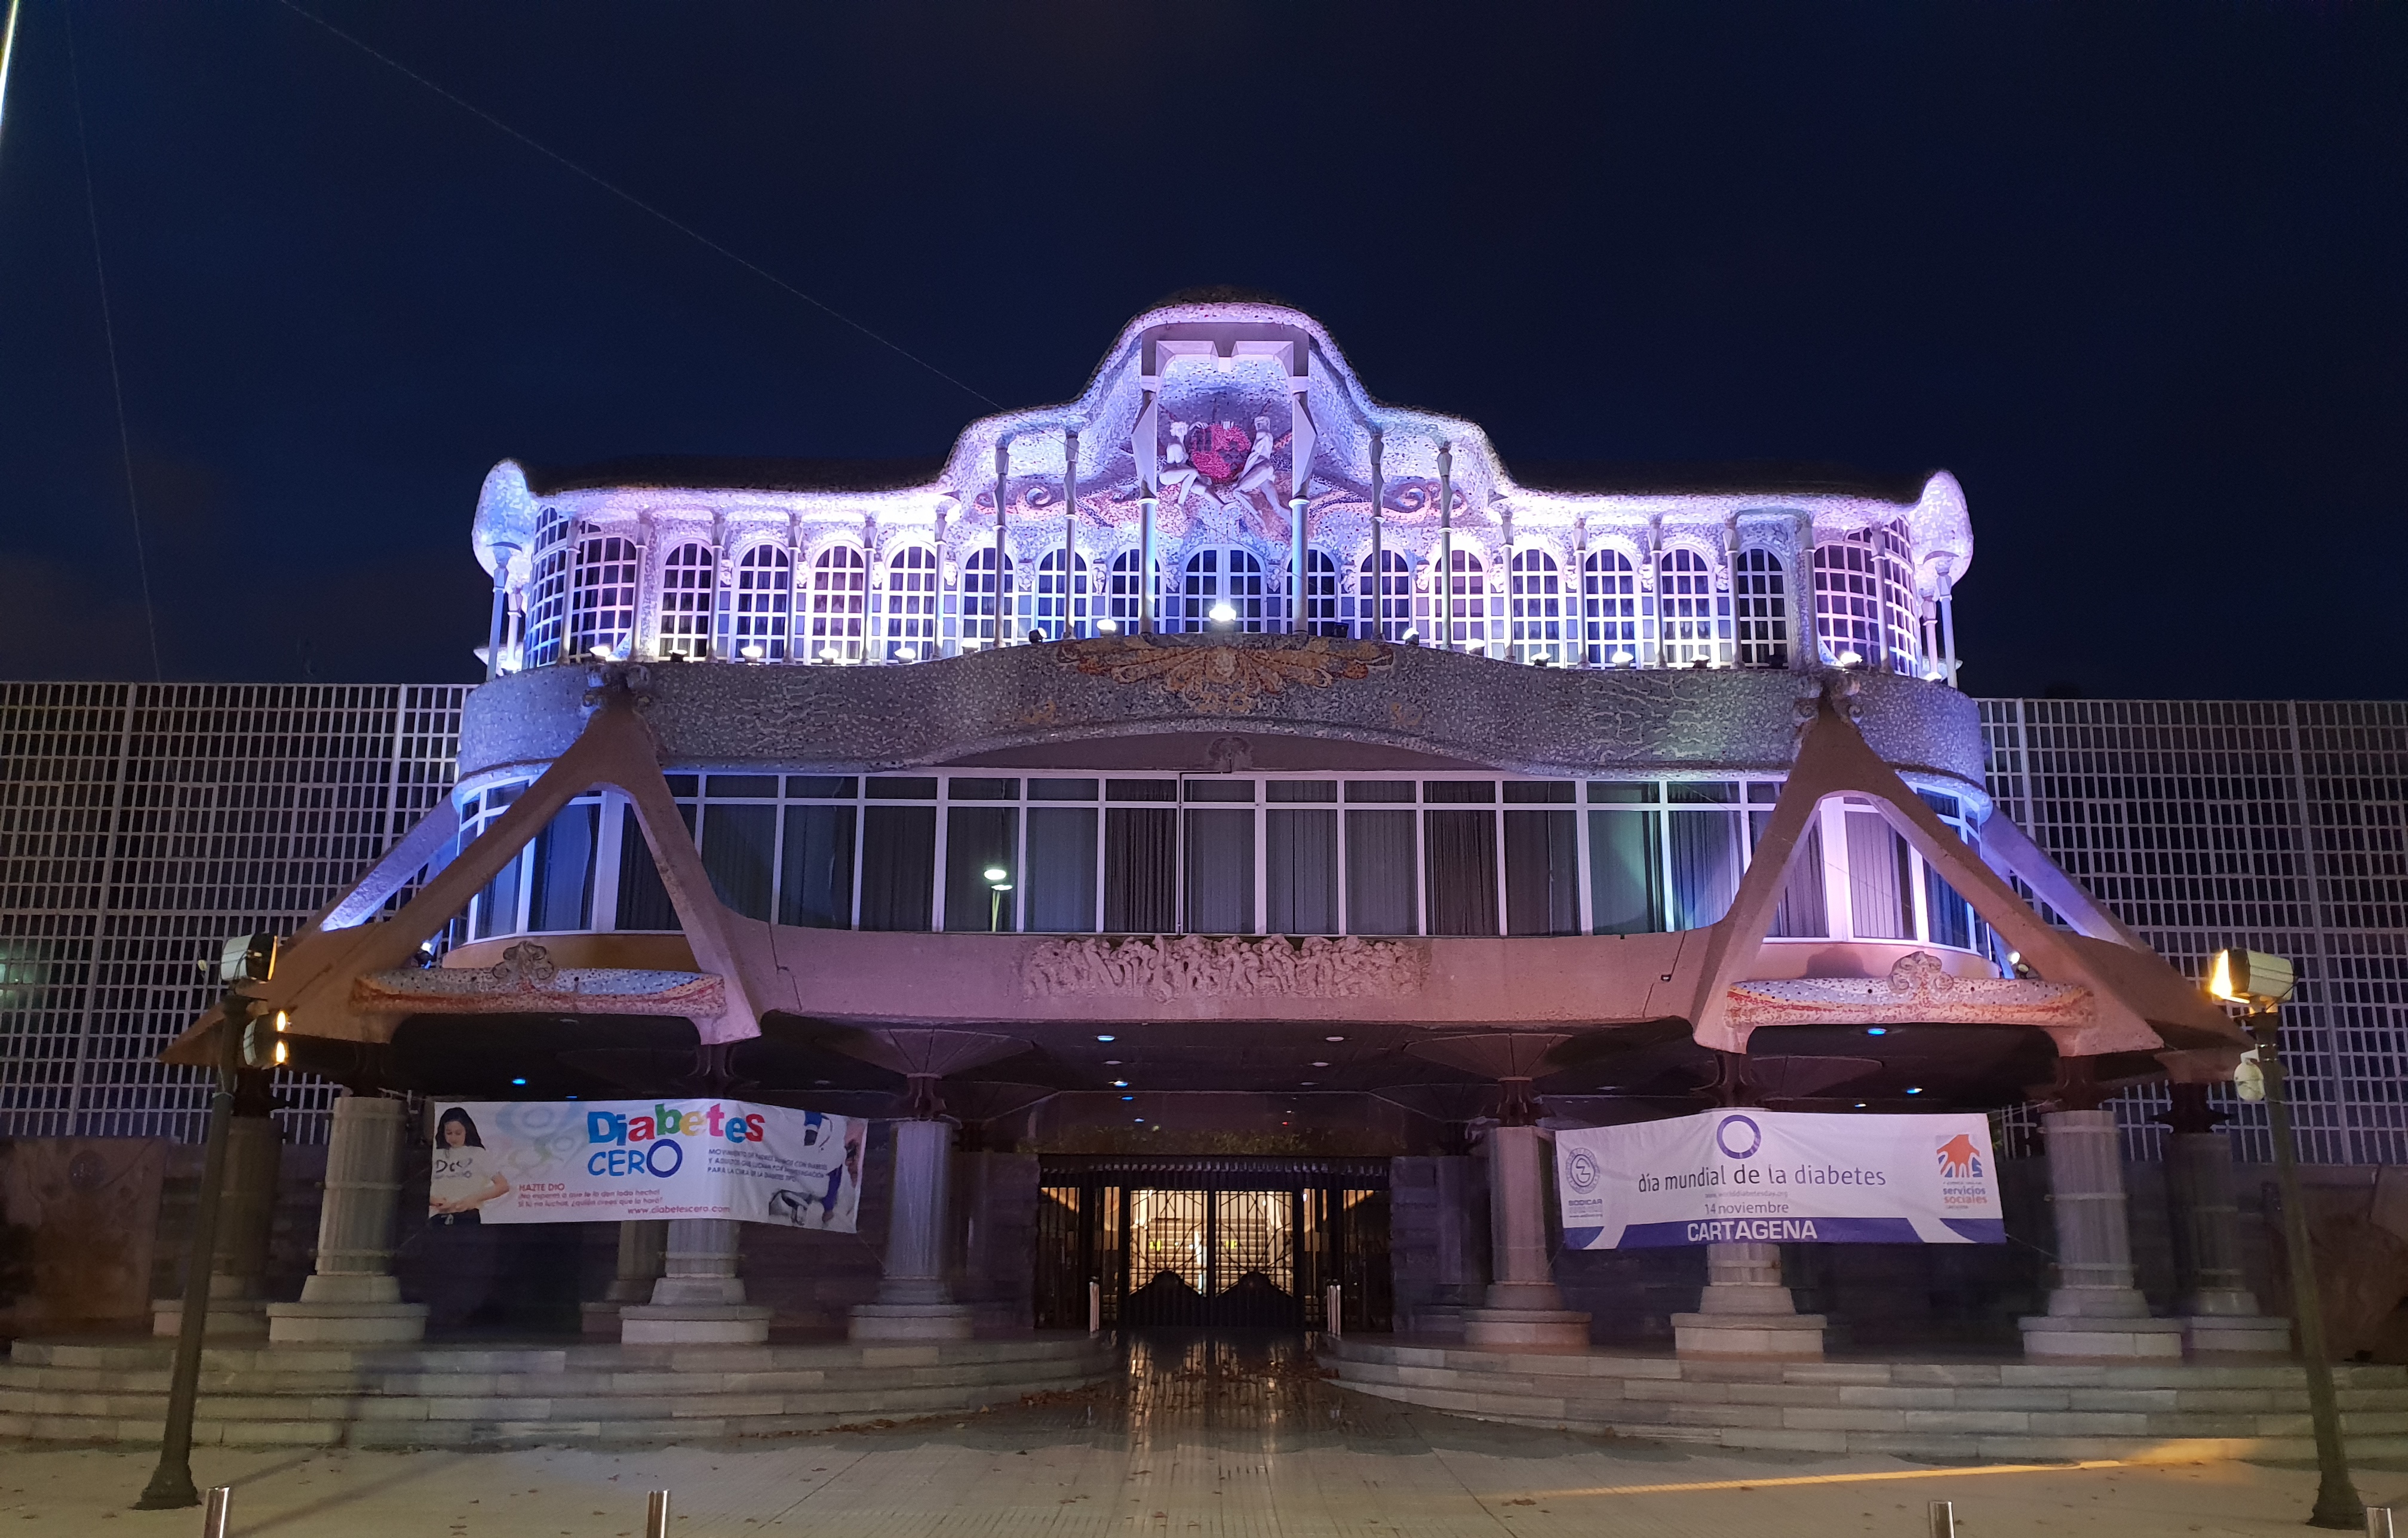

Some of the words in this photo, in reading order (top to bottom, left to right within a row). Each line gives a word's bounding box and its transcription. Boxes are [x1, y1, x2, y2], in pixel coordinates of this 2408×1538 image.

[587, 1103, 765, 1146] Diabetes
[588, 1139, 683, 1178] CERO
[1638, 1173, 1659, 1192] día
[1665, 1165, 1726, 1191] mundial
[1733, 1164, 1760, 1185] de
[1768, 1164, 1787, 1185] la
[1795, 1165, 1886, 1186] diabetes
[1943, 1186, 1986, 1195] servicios
[628, 1205, 730, 1214] www.diabetescero.com
[1704, 1203, 1716, 1214] 14
[1718, 1201, 1789, 1214] noviembre
[1687, 1220, 1817, 1241] CARTAGENA
